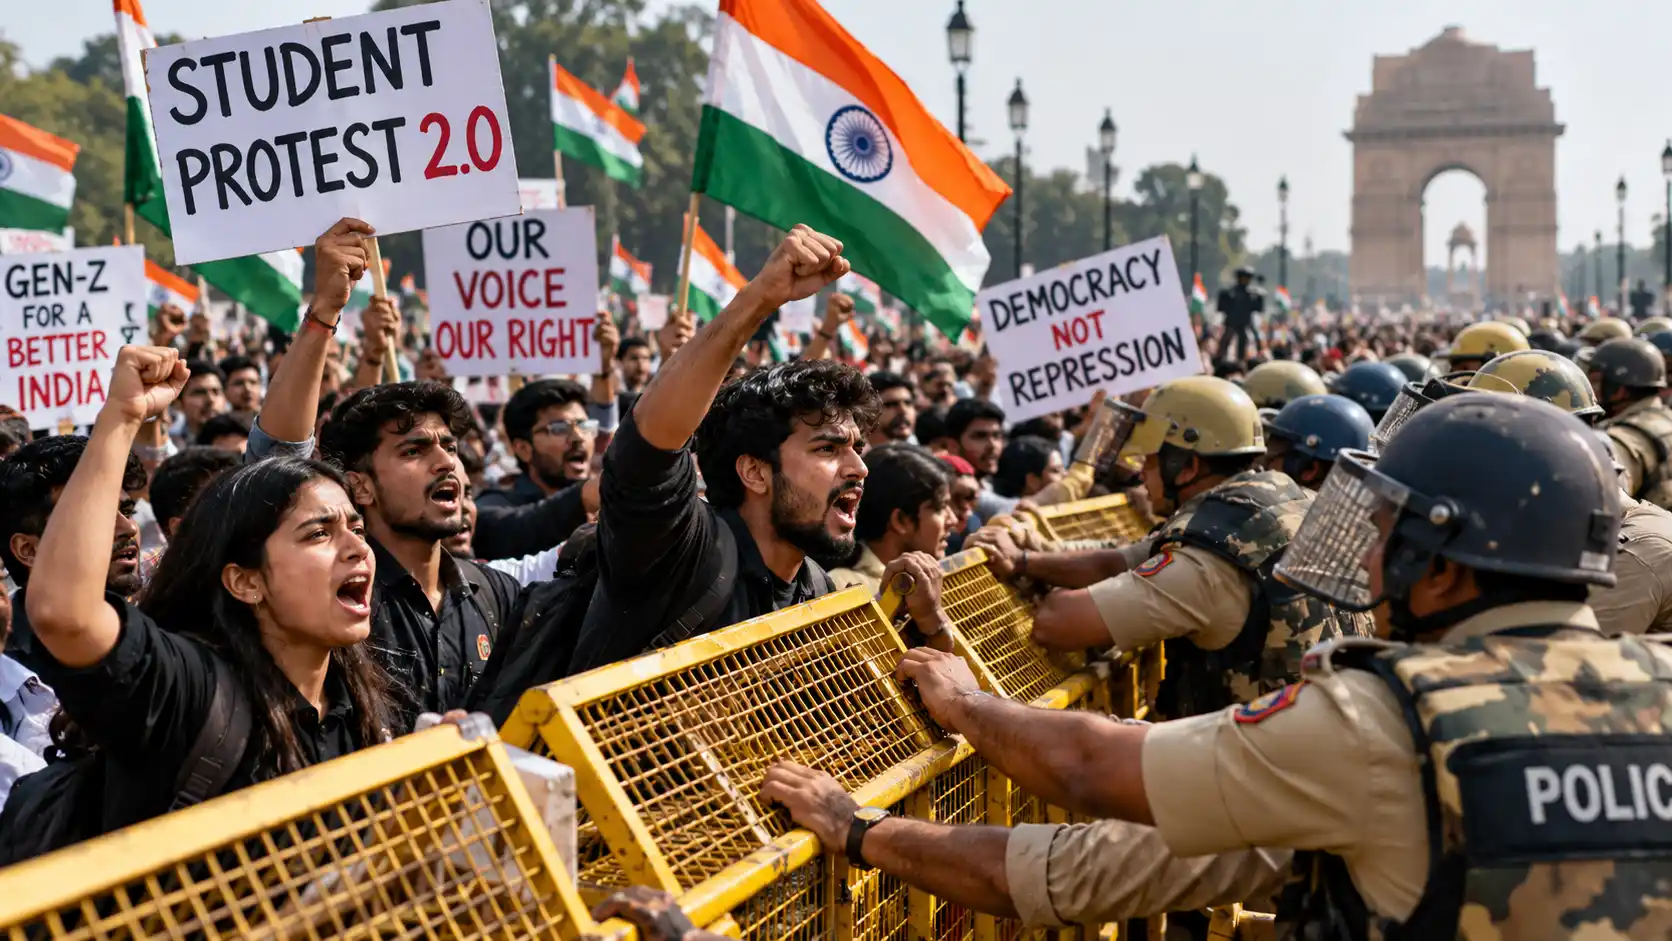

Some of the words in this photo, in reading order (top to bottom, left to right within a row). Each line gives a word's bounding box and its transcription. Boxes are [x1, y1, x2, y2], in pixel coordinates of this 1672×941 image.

[167, 19, 441, 126] STUDENT
[175, 116, 407, 216] PROTEST
[419, 105, 503, 181] 2.0
[465, 217, 550, 261] OUR
[4, 259, 109, 299] GEN-Z
[452, 266, 568, 311] VOICE
[987, 248, 1161, 333] DEMOCRACY
[22, 303, 66, 329] FOR
[77, 301, 92, 324] A
[1050, 309, 1106, 352] NOT
[7, 330, 109, 369] BETTER
[436, 318, 497, 361] OUR
[506, 316, 596, 360] RIGHT
[1007, 326, 1187, 408] REPRESSION
[18, 369, 106, 412] INDIA
[1524, 763, 1672, 825] POLIC
